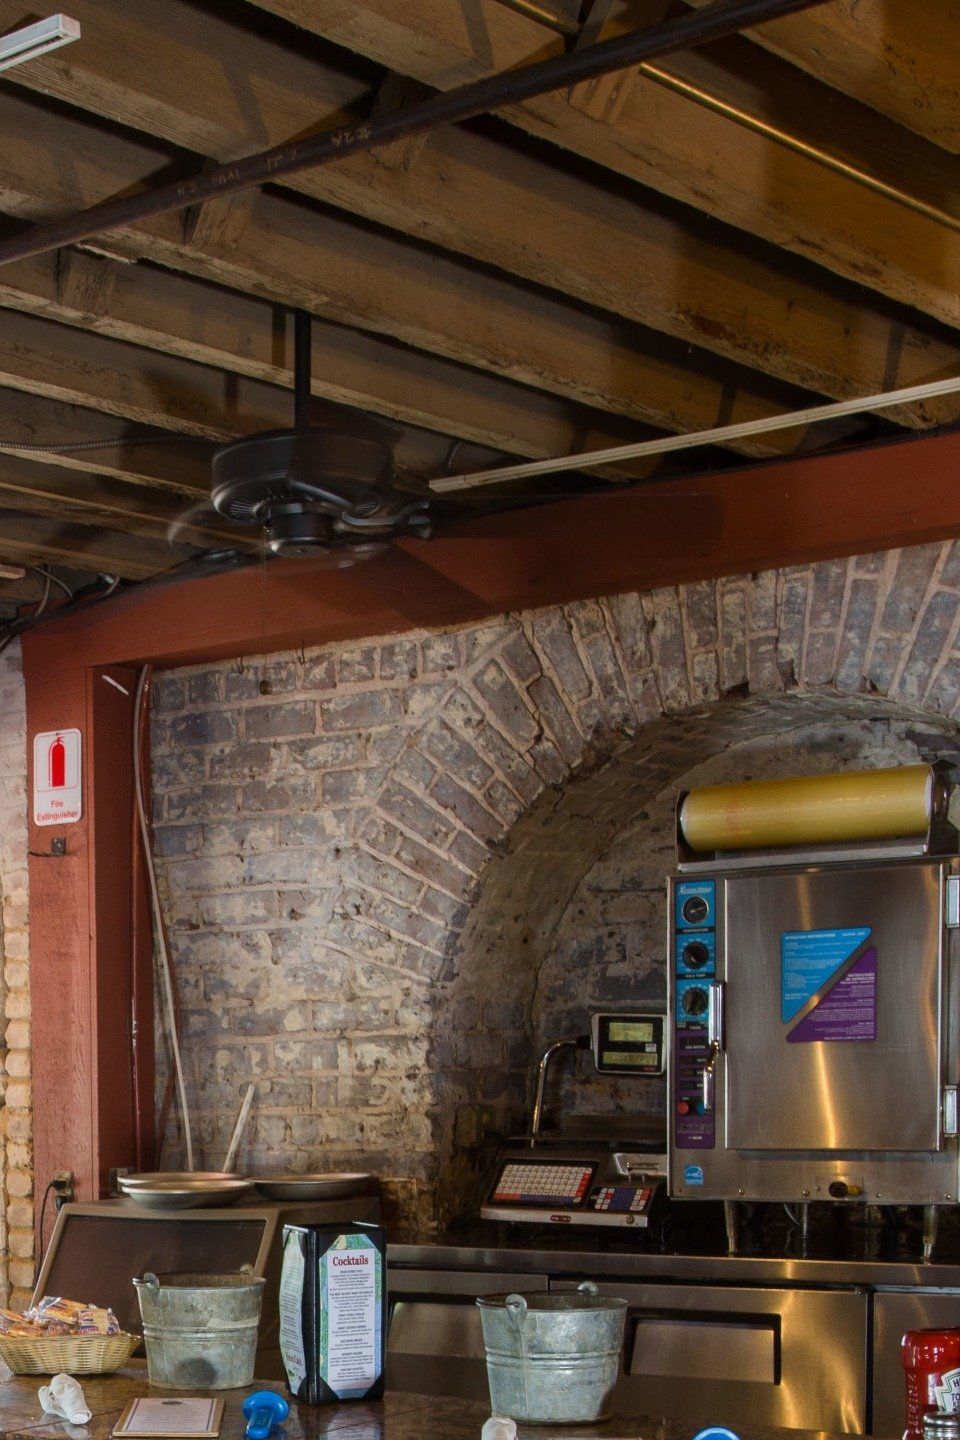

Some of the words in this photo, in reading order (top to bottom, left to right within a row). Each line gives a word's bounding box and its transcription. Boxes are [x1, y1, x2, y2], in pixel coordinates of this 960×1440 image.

[51, 800, 64, 808] Fire
[36, 811, 78, 821] Extinguisher
[333, 1255, 369, 1266] Cocktails
